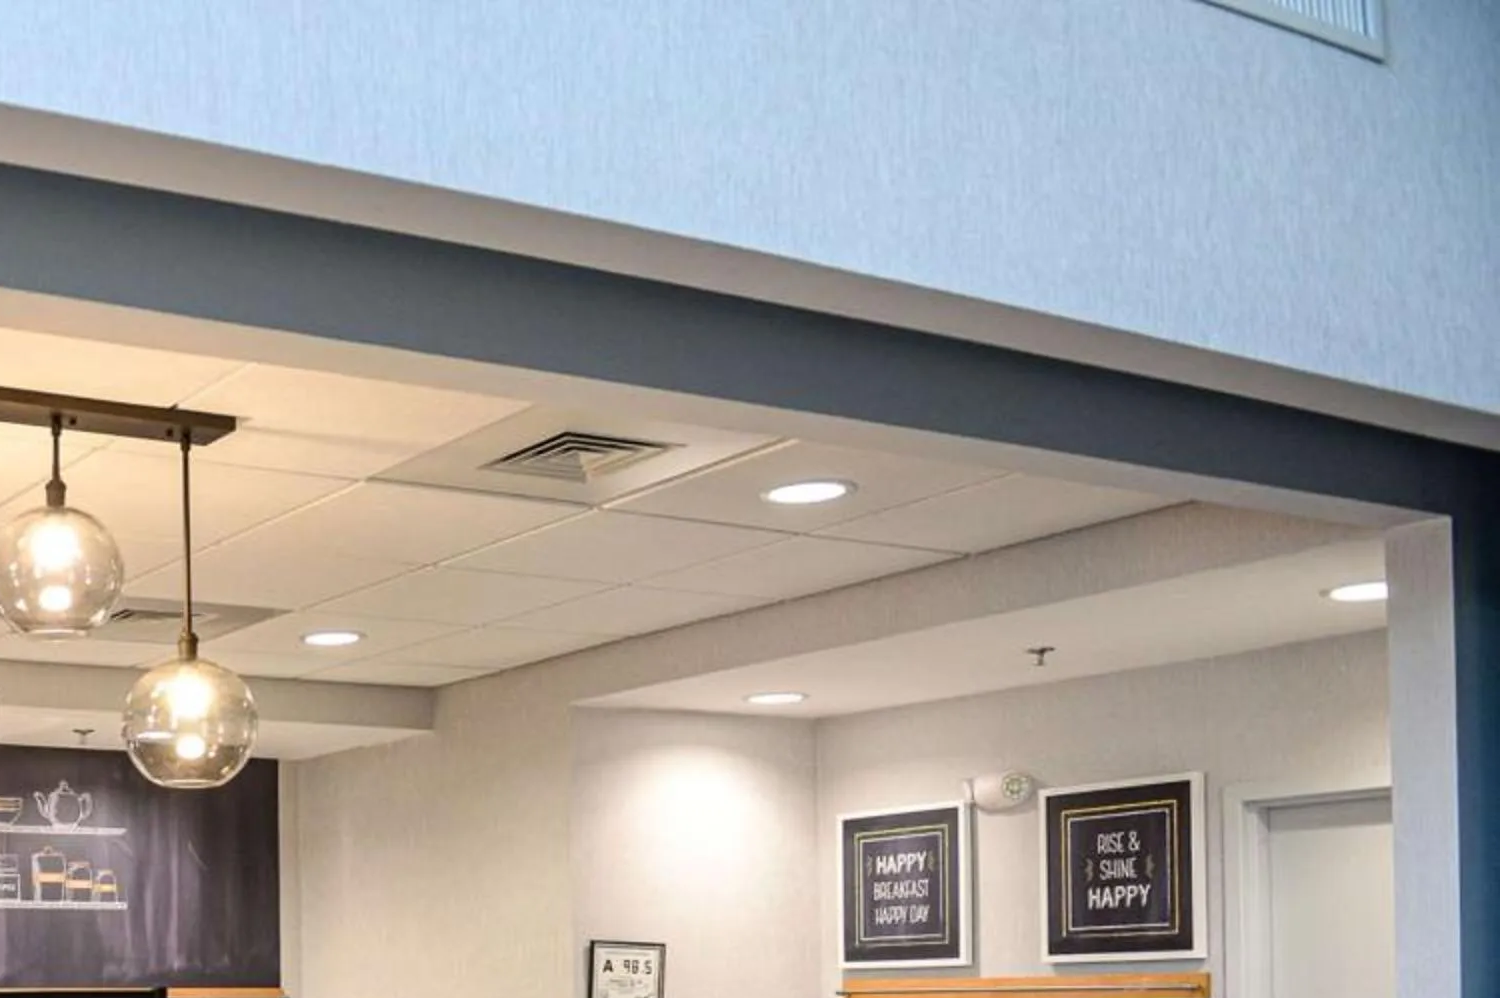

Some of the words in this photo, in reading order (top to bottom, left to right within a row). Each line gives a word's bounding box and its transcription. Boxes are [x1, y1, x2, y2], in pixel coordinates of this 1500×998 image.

[1097, 831, 1124, 854] RISE
[1128, 831, 1140, 851] &
[876, 850, 927, 875] HAPPY
[1099, 857, 1137, 880] SHINE
[873, 879, 929, 901] BREAKFAST
[1087, 883, 1151, 910] HAPPY
[875, 905, 907, 926] HAPPY
[909, 904, 930, 924] DAY
[602, 959, 614, 973] A
